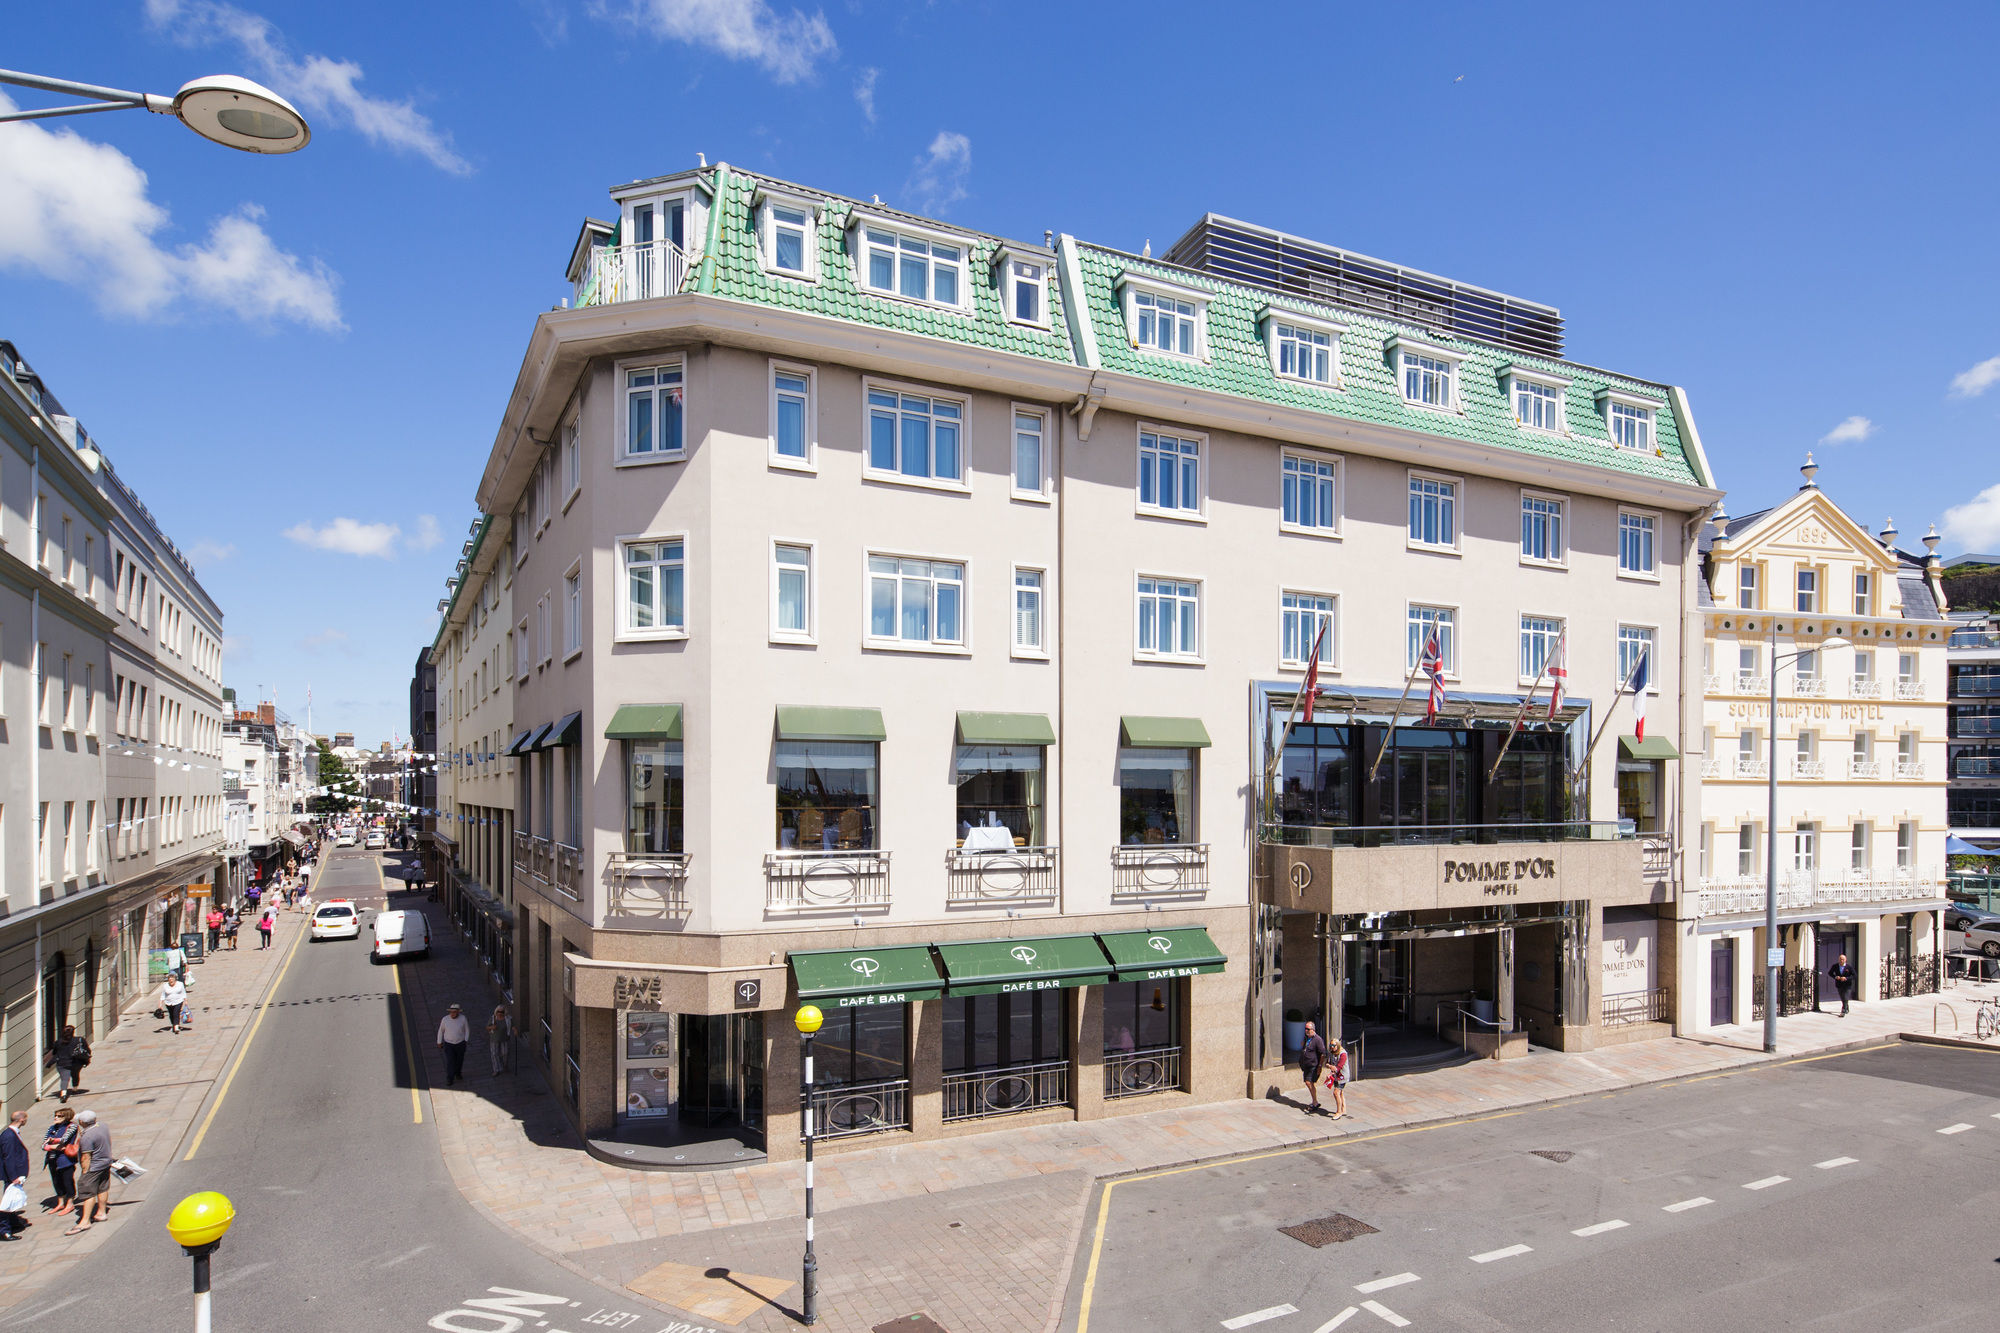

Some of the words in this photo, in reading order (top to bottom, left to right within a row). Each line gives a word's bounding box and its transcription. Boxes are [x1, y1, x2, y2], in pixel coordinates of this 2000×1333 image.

[1796, 526, 1828, 544] 1899
[1840, 704, 1884, 721] HOTEL
[1444, 860, 1510, 883] POMME
[1514, 857, 1555, 880] D'OR
[1483, 883, 1519, 897] HOTEL
[1602, 961, 1624, 972] OMME
[1627, 959, 1645, 970] D'OR
[1148, 969, 1175, 980] CAFÉ
[1178, 967, 1199, 977] BAR
[615, 974, 662, 989] CAFÉ
[1002, 980, 1033, 992] CAFÉ
[1036, 979, 1060, 989] BAR
[615, 988, 662, 1006] BAR
[839, 994, 875, 1007] CAFÉ
[879, 993, 906, 1004] BAR
[581, 1308, 641, 1329] LEFT
